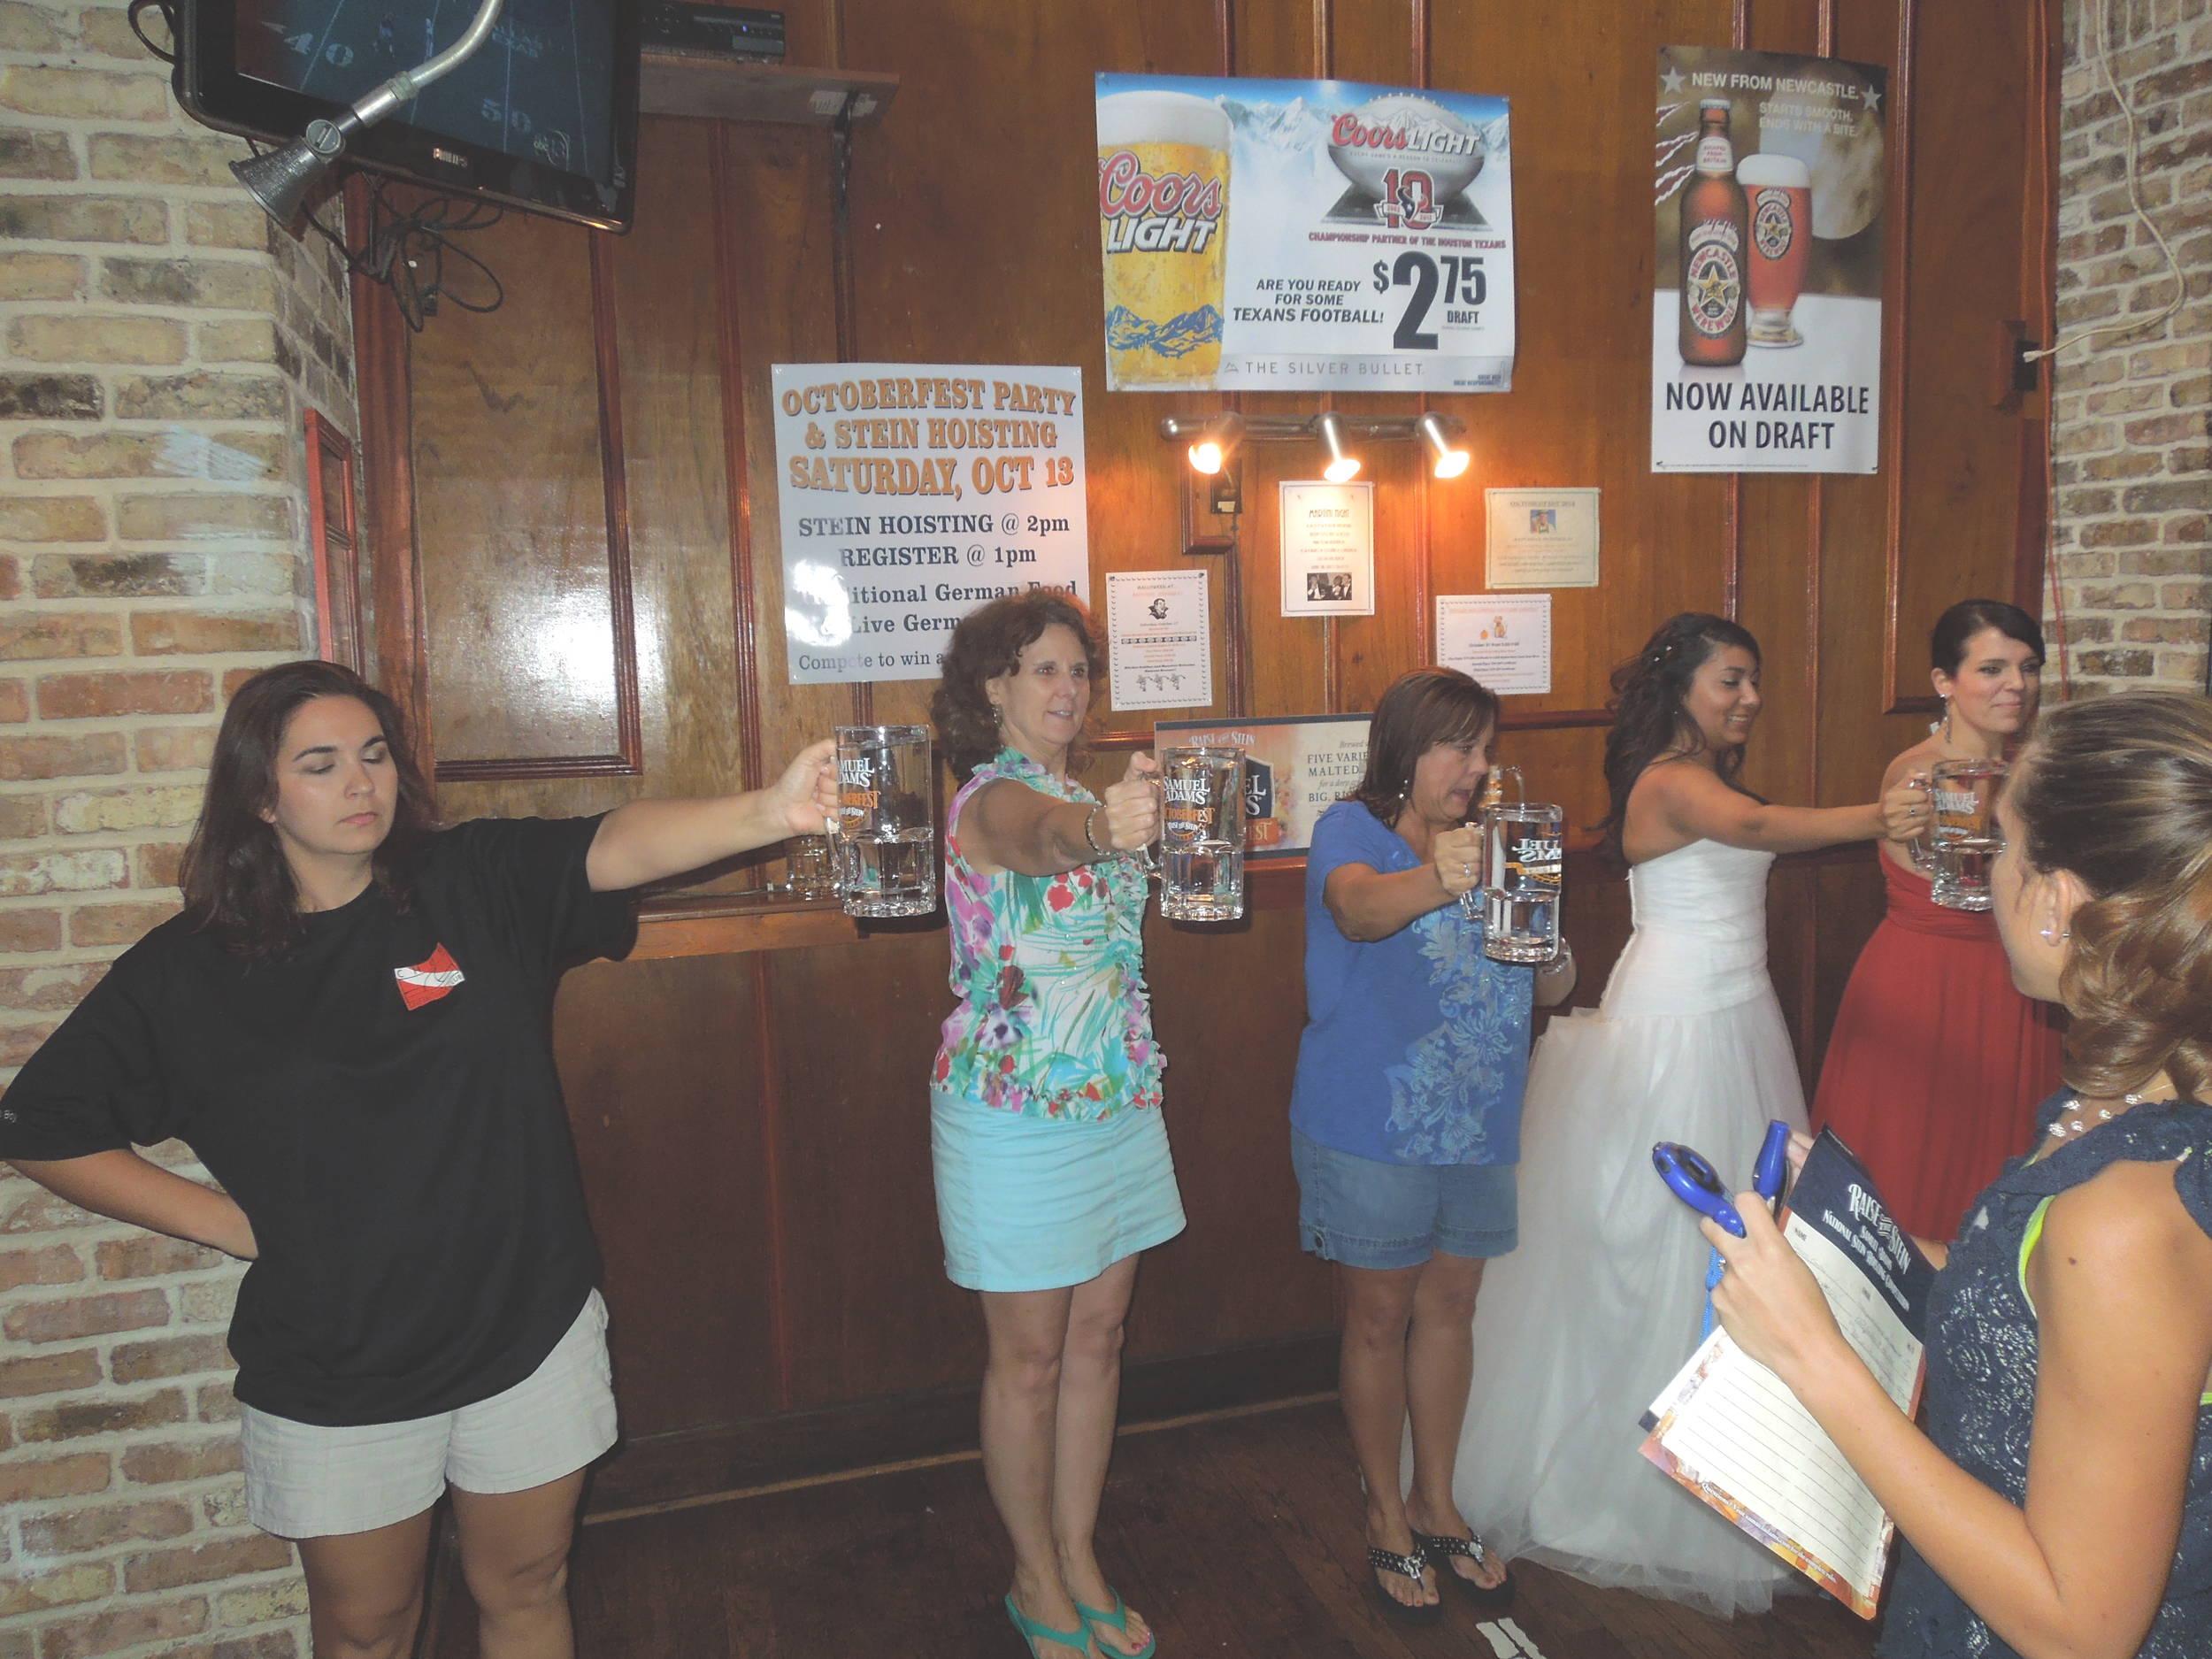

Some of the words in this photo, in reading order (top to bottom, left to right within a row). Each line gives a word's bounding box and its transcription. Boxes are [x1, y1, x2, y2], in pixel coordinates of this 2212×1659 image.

[1692, 73, 1726, 87] NEW
[1731, 74, 1772, 89] FROM
[1759, 102, 1803, 115] STARTS
[1331, 113, 1409, 150] Coors
[1407, 129, 1480, 156] LIGHT
[1097, 150, 1223, 219] Coors
[1107, 217, 1218, 254] LIGHT
[1372, 234, 1407, 244] PARTNER
[1409, 235, 1419, 245] OF
[1421, 236, 1436, 246] THE
[1438, 237, 1472, 248] HOUSTON
[1475, 238, 1507, 249] TEXANS
[1691, 249, 1737, 278] NEWCASTLE
[1256, 279, 1285, 291] ARE
[1288, 279, 1316, 292] YOU
[1317, 280, 1361, 293] READY
[1275, 294, 1302, 305] FOR
[1304, 294, 1344, 306] SOME
[1233, 307, 1296, 322] TEXANS
[1300, 308, 1384, 324] FOOTBALL!
[1447, 311, 1479, 324] DRAFT
[1691, 304, 1736, 331] WEREWOLF
[1245, 362, 1277, 374] THE
[1288, 362, 1348, 375] SILVER
[1359, 363, 1422, 376] BULLET
[781, 378, 986, 417] OCTOBERFEST
[993, 380, 1076, 416] PARTY
[1666, 382, 1732, 411] NOW
[1740, 383, 1870, 414] AVAILABLE
[805, 421, 826, 449] &
[834, 418, 919, 449] STEIN
[926, 418, 1058, 449] HOISTING
[1709, 420, 1750, 448] ON
[1755, 421, 1834, 449] DRAFT
[788, 455, 963, 501] SATURDAY,
[972, 456, 1035, 494] OCT
[1046, 456, 1074, 487] 13
[799, 516, 871, 537] STEIN
[879, 514, 993, 535] HOISTING
[1001, 513, 1019, 535] @
[1027, 515, 1070, 537] 2pm
[841, 546, 959, 567] REGISTER
[967, 544, 985, 566] @
[994, 547, 1037, 567] 1pm
[848, 584, 927, 603] itional
[935, 583, 1018, 602] German
[851, 617, 895, 634] Live
[903, 614, 960, 632] Germ
[879, 652, 895, 666] to
[900, 651, 930, 666] win
[839, 757, 875, 773] MUEL
[1308, 753, 1333, 764] FIVE
[1336, 751, 1369, 763] VARIE
[839, 772, 872, 787] DAMS
[1309, 765, 1359, 776] MALTED
[1164, 776, 1210, 792] SAMUEL
[1165, 790, 1208, 805] ADAMS
[1848, 1184, 1883, 1227] RAISE
[1888, 1225, 1911, 1275] STEIN
